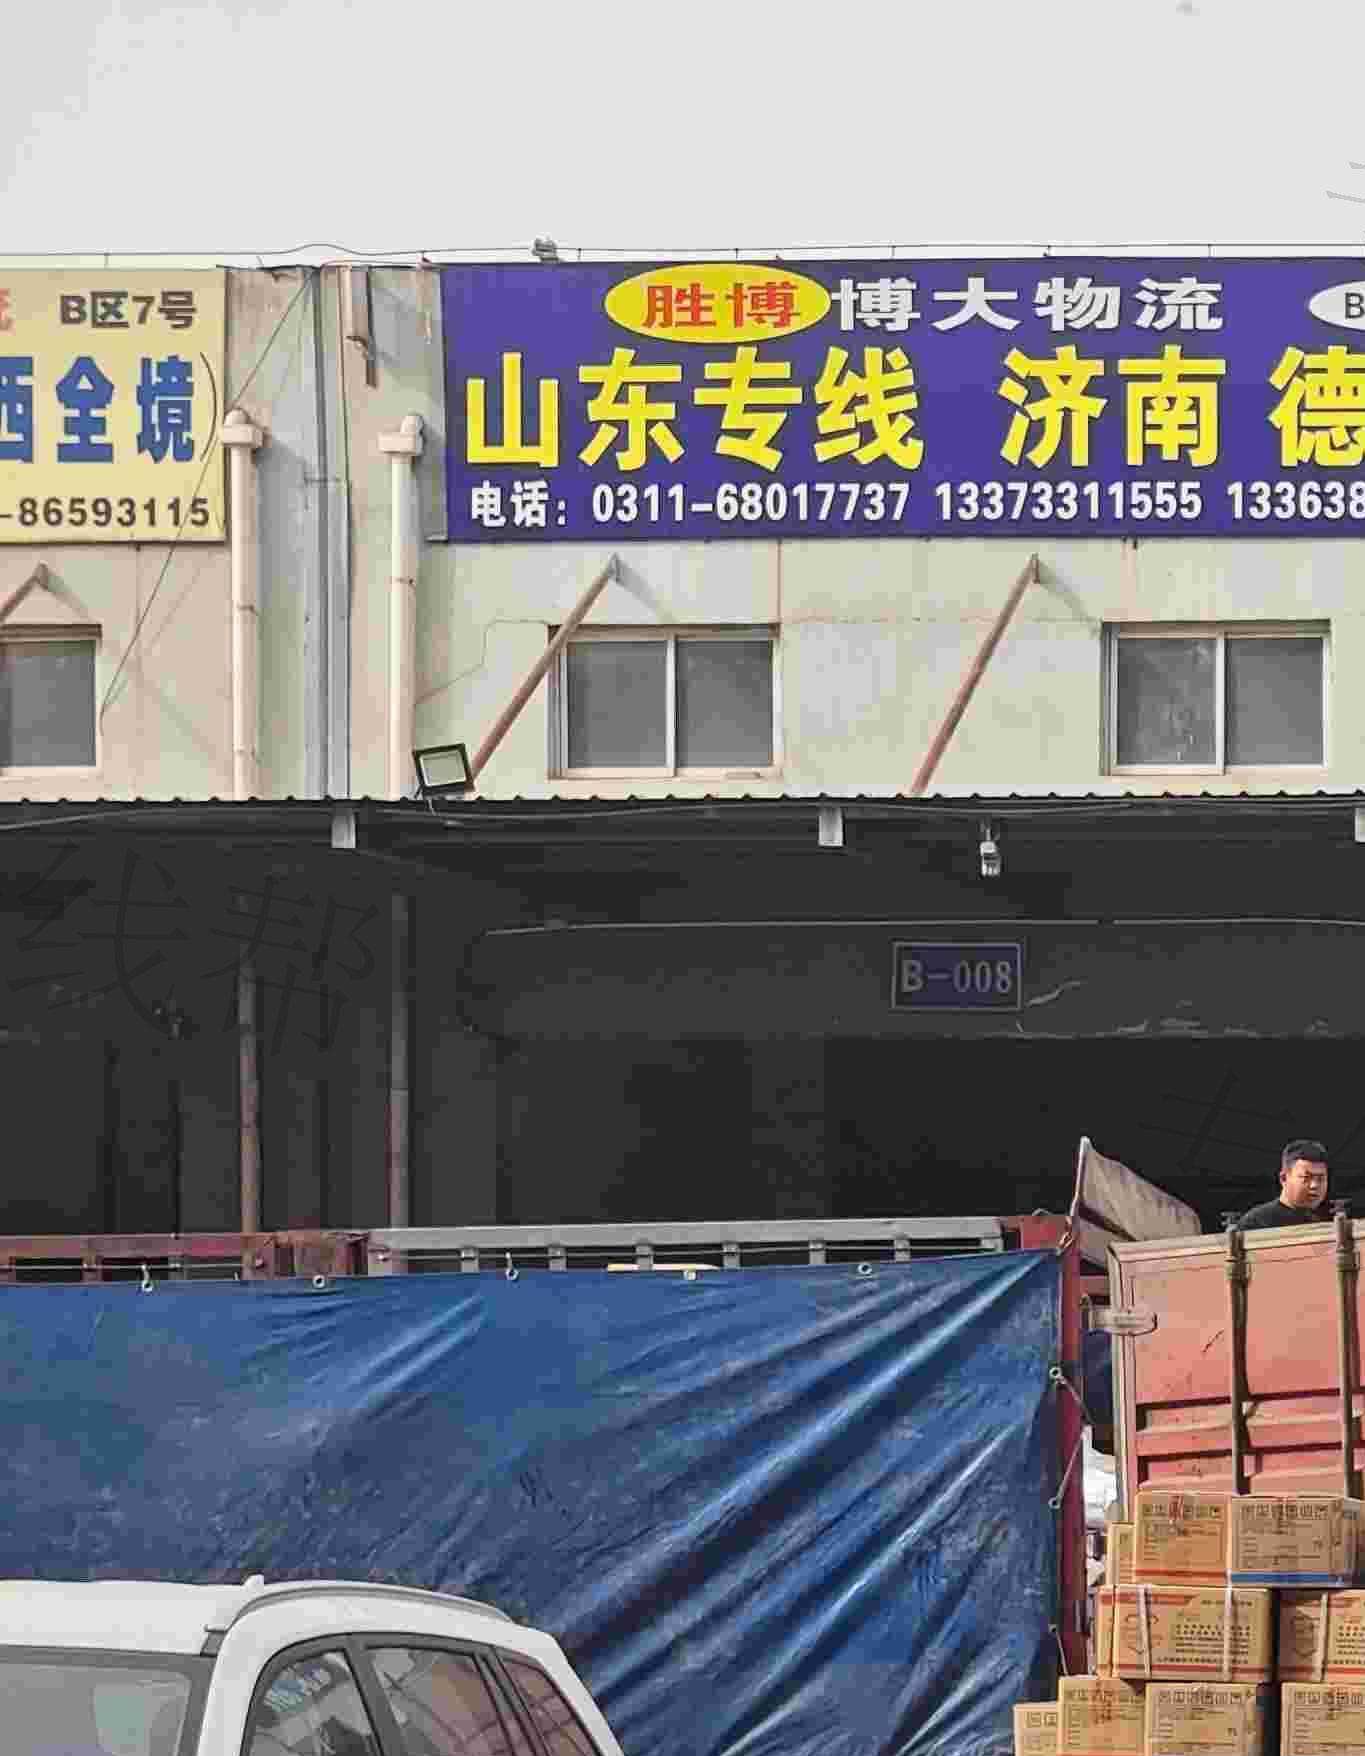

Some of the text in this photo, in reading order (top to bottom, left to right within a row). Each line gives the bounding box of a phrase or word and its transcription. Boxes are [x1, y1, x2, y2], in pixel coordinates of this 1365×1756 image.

[60, 290, 197, 330] B区7号
[641, 280, 800, 329] 胜博
[831, 276, 1224, 333] 博大物流
[465, 346, 925, 471] 山东专线
[997, 346, 1227, 470] 济南
[592, 481, 910, 526] 0311-68017737
[935, 480, 1203, 522] 13373311555
[903, 960, 1012, 992] B-008
